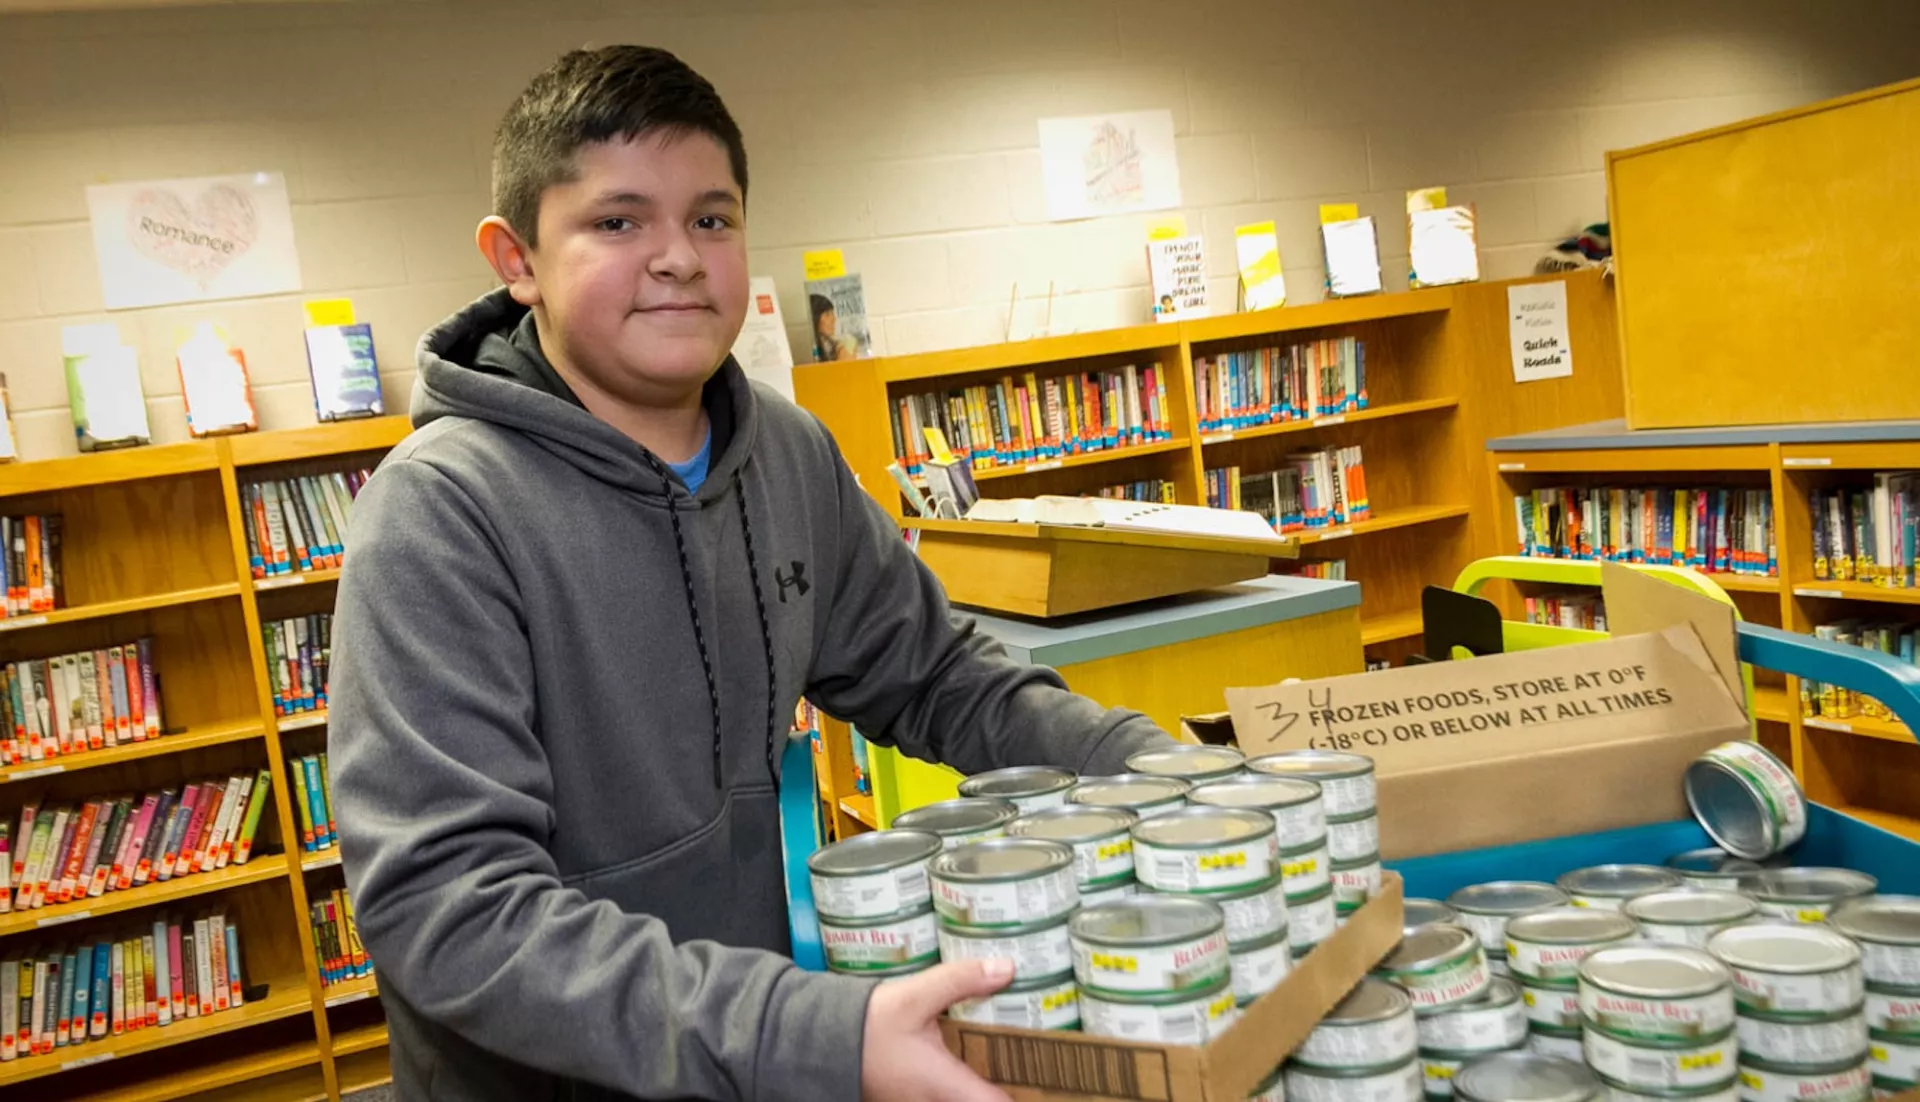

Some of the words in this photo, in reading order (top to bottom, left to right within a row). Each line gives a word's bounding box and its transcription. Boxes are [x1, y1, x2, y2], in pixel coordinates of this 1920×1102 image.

[140, 216, 234, 253] Romance
[1308, 699, 1400, 727] FROZEN
[1404, 688, 1491, 714] FOODS,
[1492, 675, 1570, 702] STORE
[1573, 671, 1602, 691] AT
[1392, 723, 1428, 742] OR
[1430, 710, 1512, 738] BELOW
[1519, 705, 1549, 725] AT
[1556, 700, 1598, 720] ALL
[1600, 687, 1674, 713] TIMES
